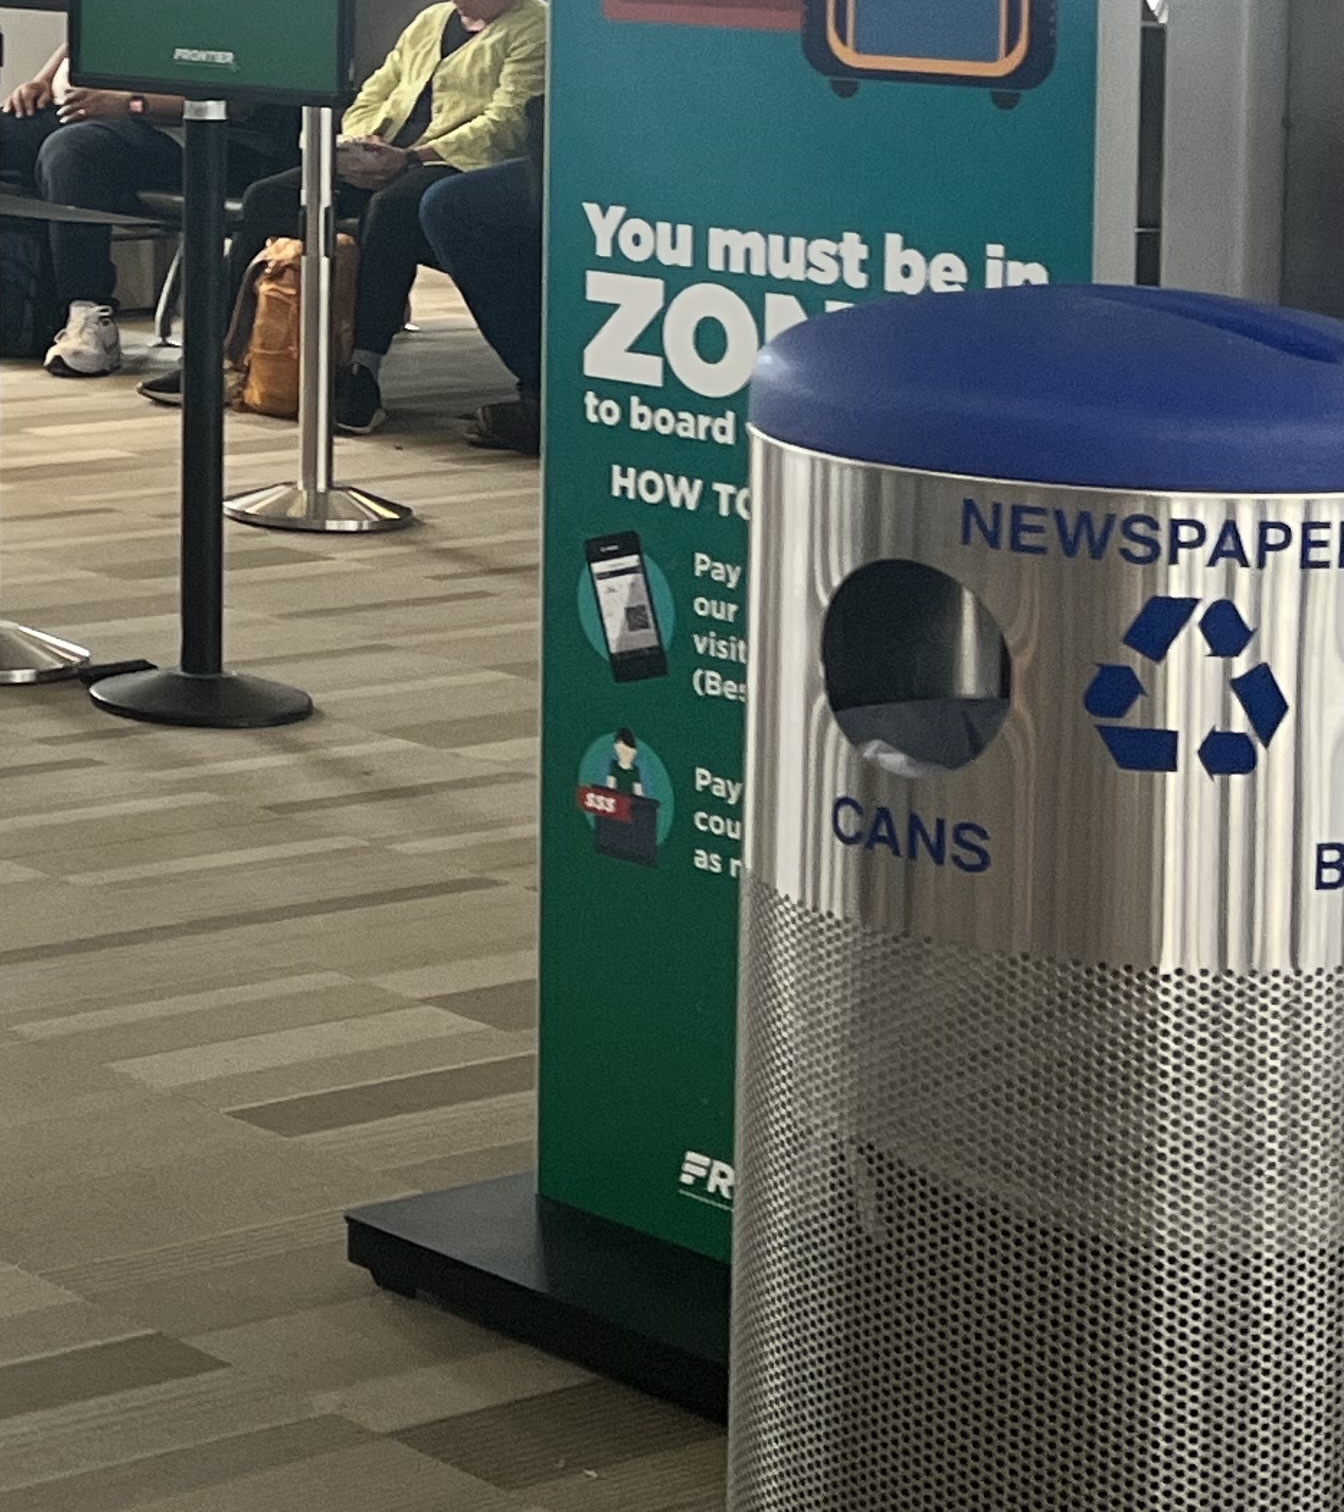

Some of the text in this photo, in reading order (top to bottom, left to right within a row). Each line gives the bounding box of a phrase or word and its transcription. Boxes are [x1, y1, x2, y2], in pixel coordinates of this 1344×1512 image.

[173, 48, 235, 65] FRONTIER
[582, 201, 1050, 295] You must be in
[584, 390, 736, 445] to board
[610, 463, 703, 512] HOW
[960, 498, 1344, 571] NEWSPAPE
[693, 551, 742, 590] Pay
[693, 595, 739, 623] our
[692, 630, 748, 664] visit
[694, 766, 742, 804] Pay
[694, 809, 741, 840] cou
[831, 795, 992, 874] CANS
[693, 848, 722, 874] as
